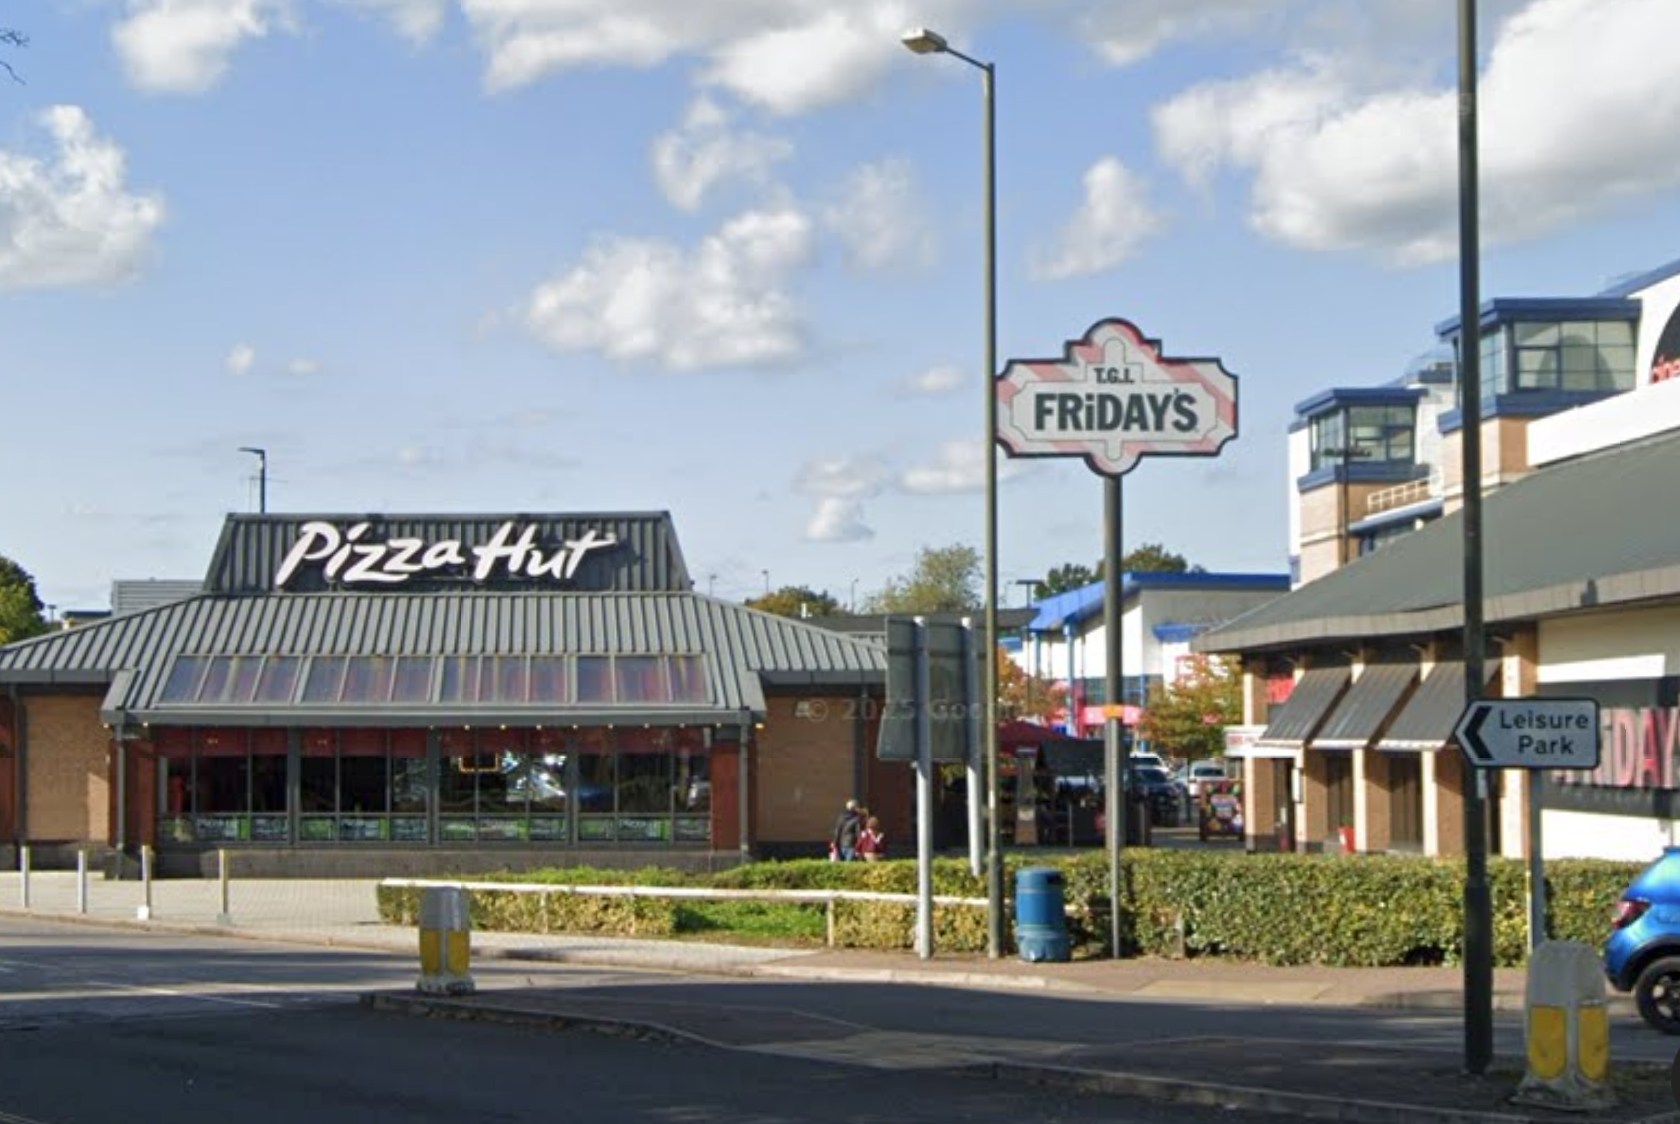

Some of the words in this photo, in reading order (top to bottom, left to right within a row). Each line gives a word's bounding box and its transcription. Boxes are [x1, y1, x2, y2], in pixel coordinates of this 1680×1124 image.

[275, 521, 466, 586] Pizza
[472, 521, 617, 580] Hut
[1500, 709, 1589, 730] Leisure
[1517, 734, 1575, 755] Park
